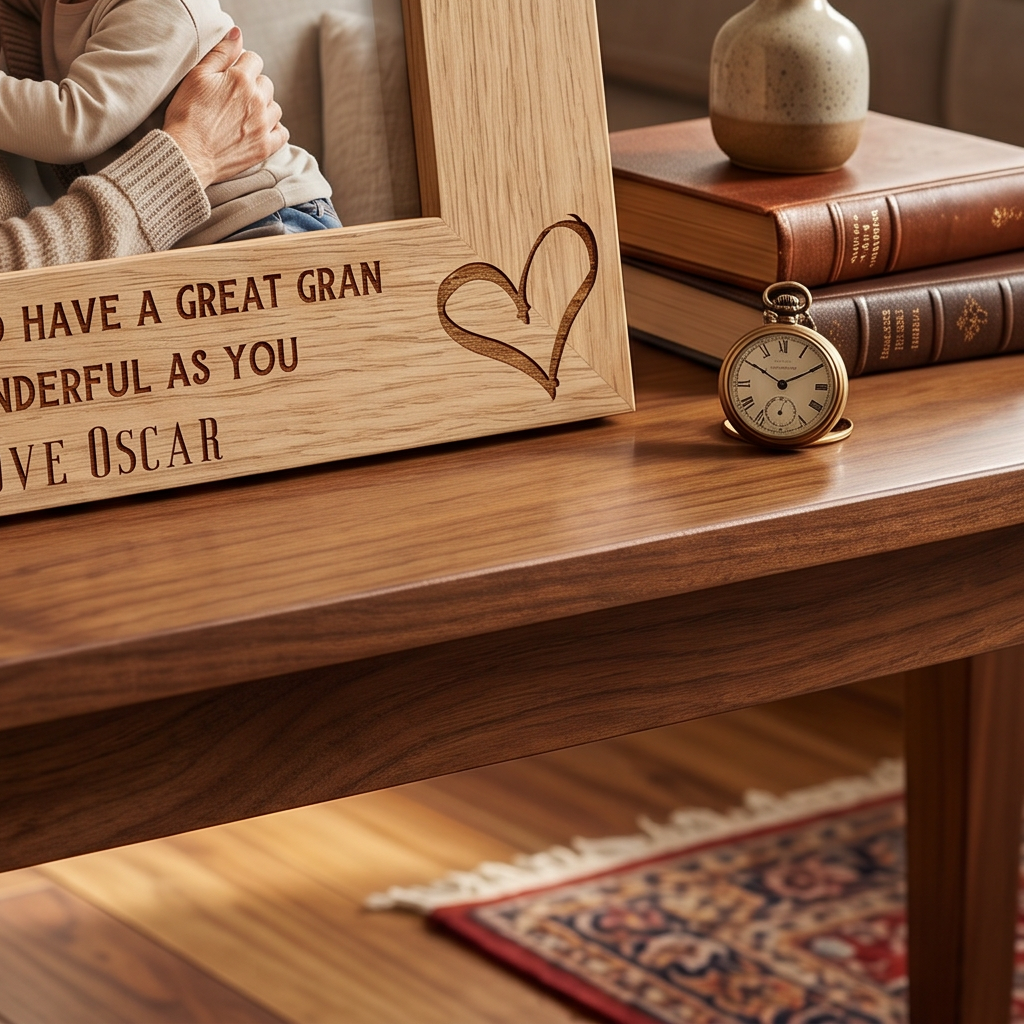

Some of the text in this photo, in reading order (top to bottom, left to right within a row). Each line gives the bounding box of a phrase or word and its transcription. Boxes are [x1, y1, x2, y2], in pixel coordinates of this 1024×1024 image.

[22, 294, 121, 342] HAVE
[137, 290, 162, 326] A
[176, 274, 281, 319] GREAT
[297, 261, 382, 303] GRAN
[167, 350, 210, 389] AS
[223, 337, 298, 379] YOU
[88, 418, 223, 478] OSCAR
